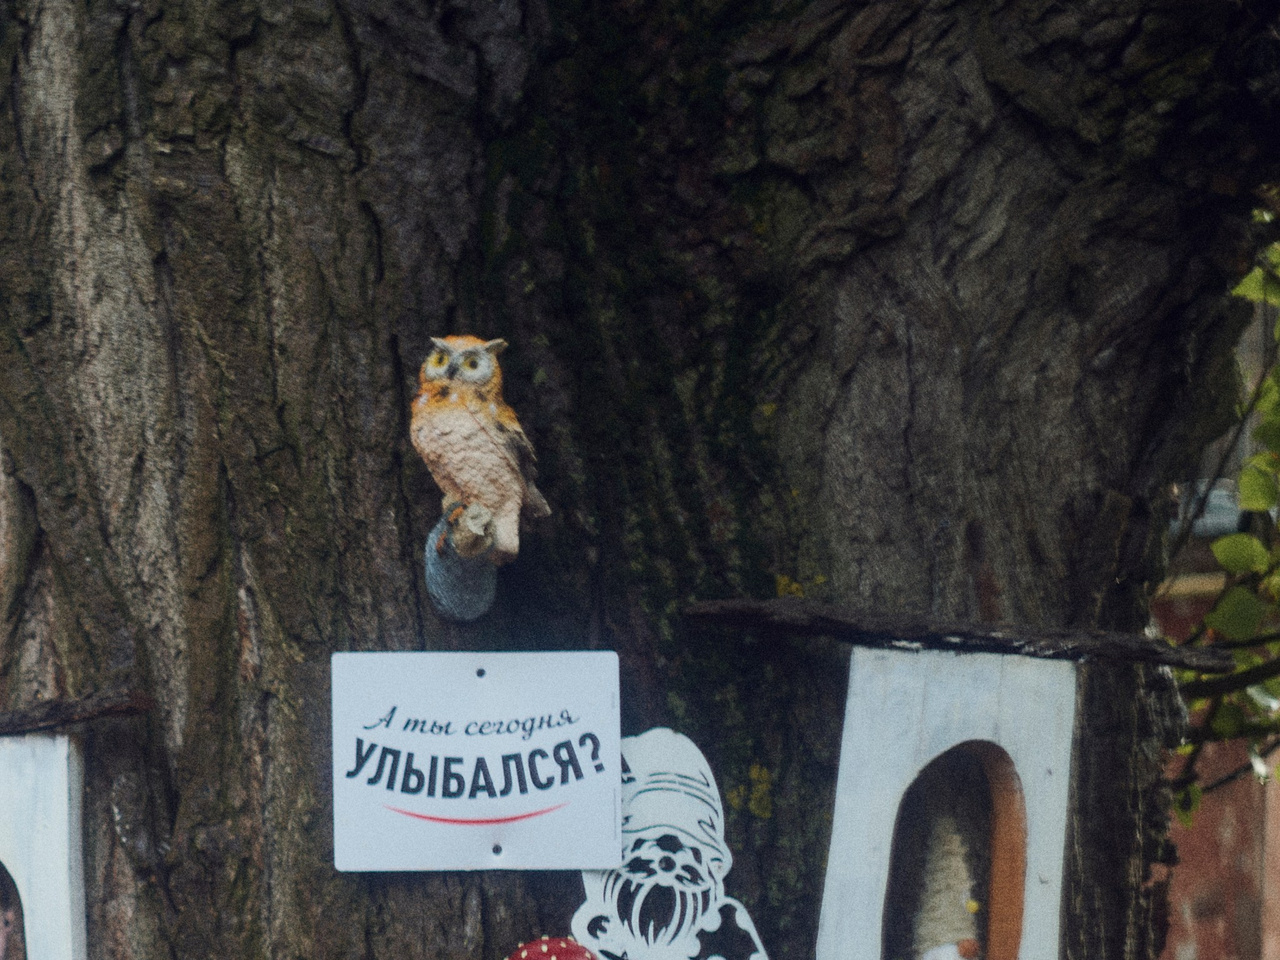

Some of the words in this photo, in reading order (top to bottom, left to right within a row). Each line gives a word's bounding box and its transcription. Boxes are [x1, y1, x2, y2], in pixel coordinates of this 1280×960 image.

[363, 706, 397, 730] А
[403, 717, 456, 734] ты
[464, 709, 580, 740] сегодня
[345, 733, 605, 799] УЛЫБАЛСЯ?
